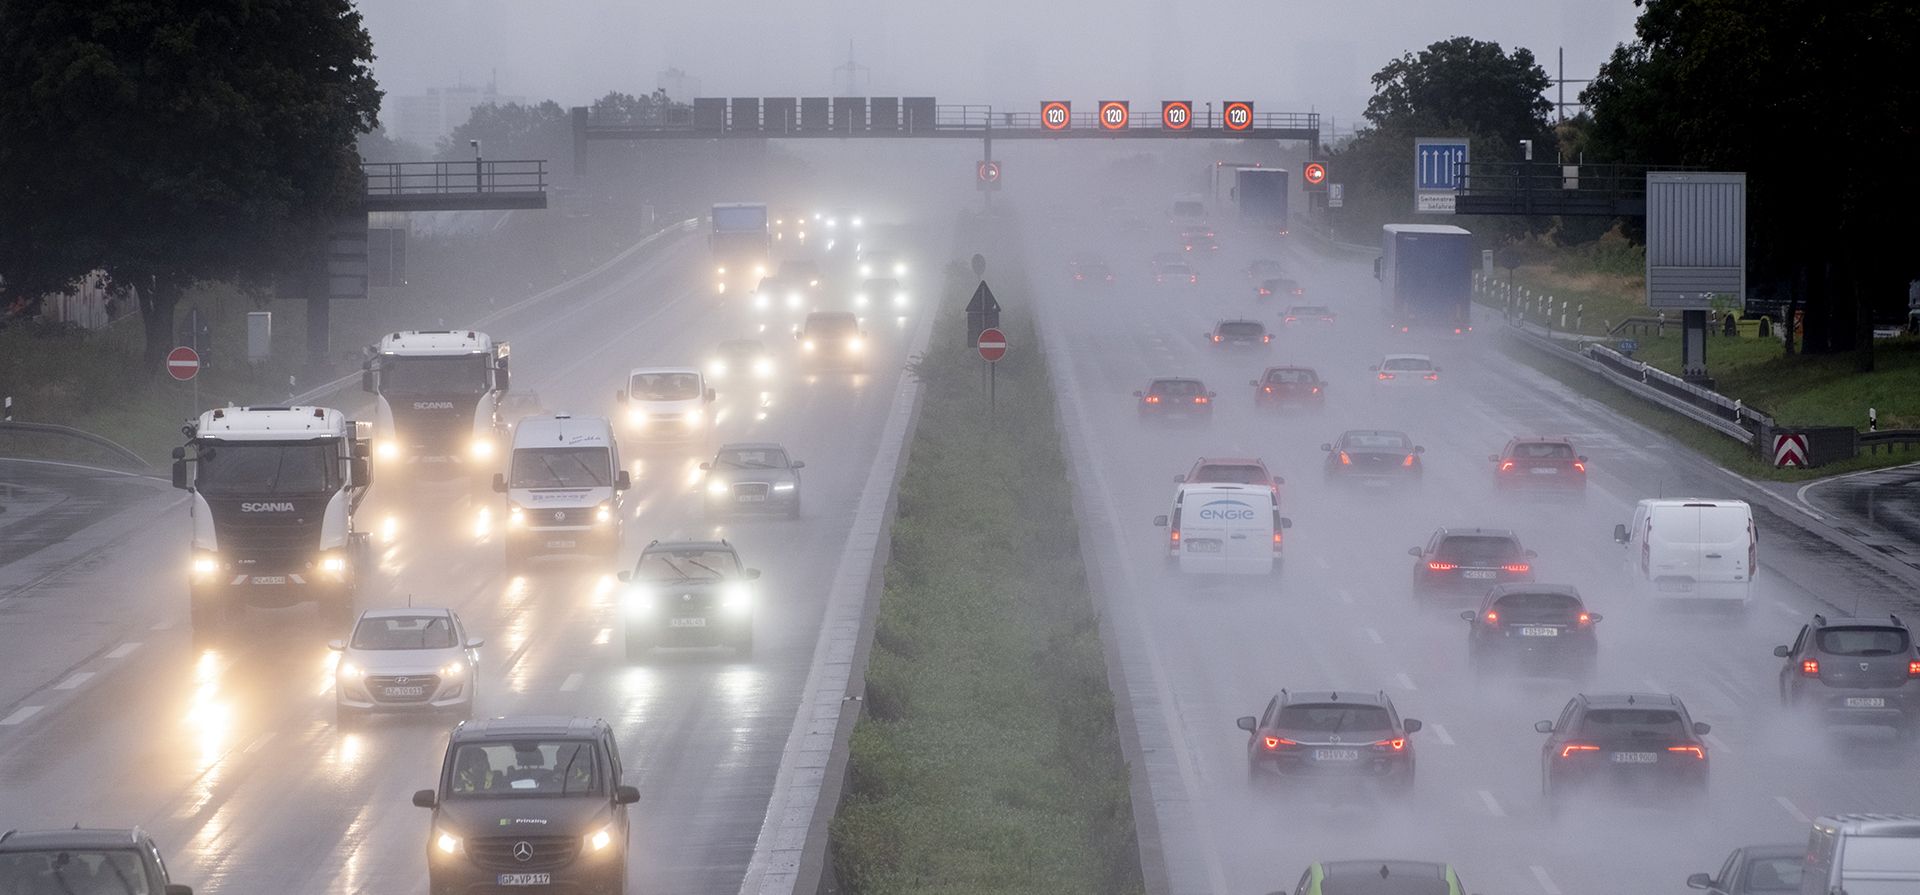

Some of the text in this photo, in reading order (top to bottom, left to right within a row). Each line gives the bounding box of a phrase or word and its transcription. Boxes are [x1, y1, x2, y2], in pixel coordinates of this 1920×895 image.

[1048, 109, 1064, 123] 120
[1106, 109, 1122, 123] 120
[1169, 109, 1185, 123] 120
[1231, 109, 1247, 124] 120
[241, 502, 295, 512] SCANIA
